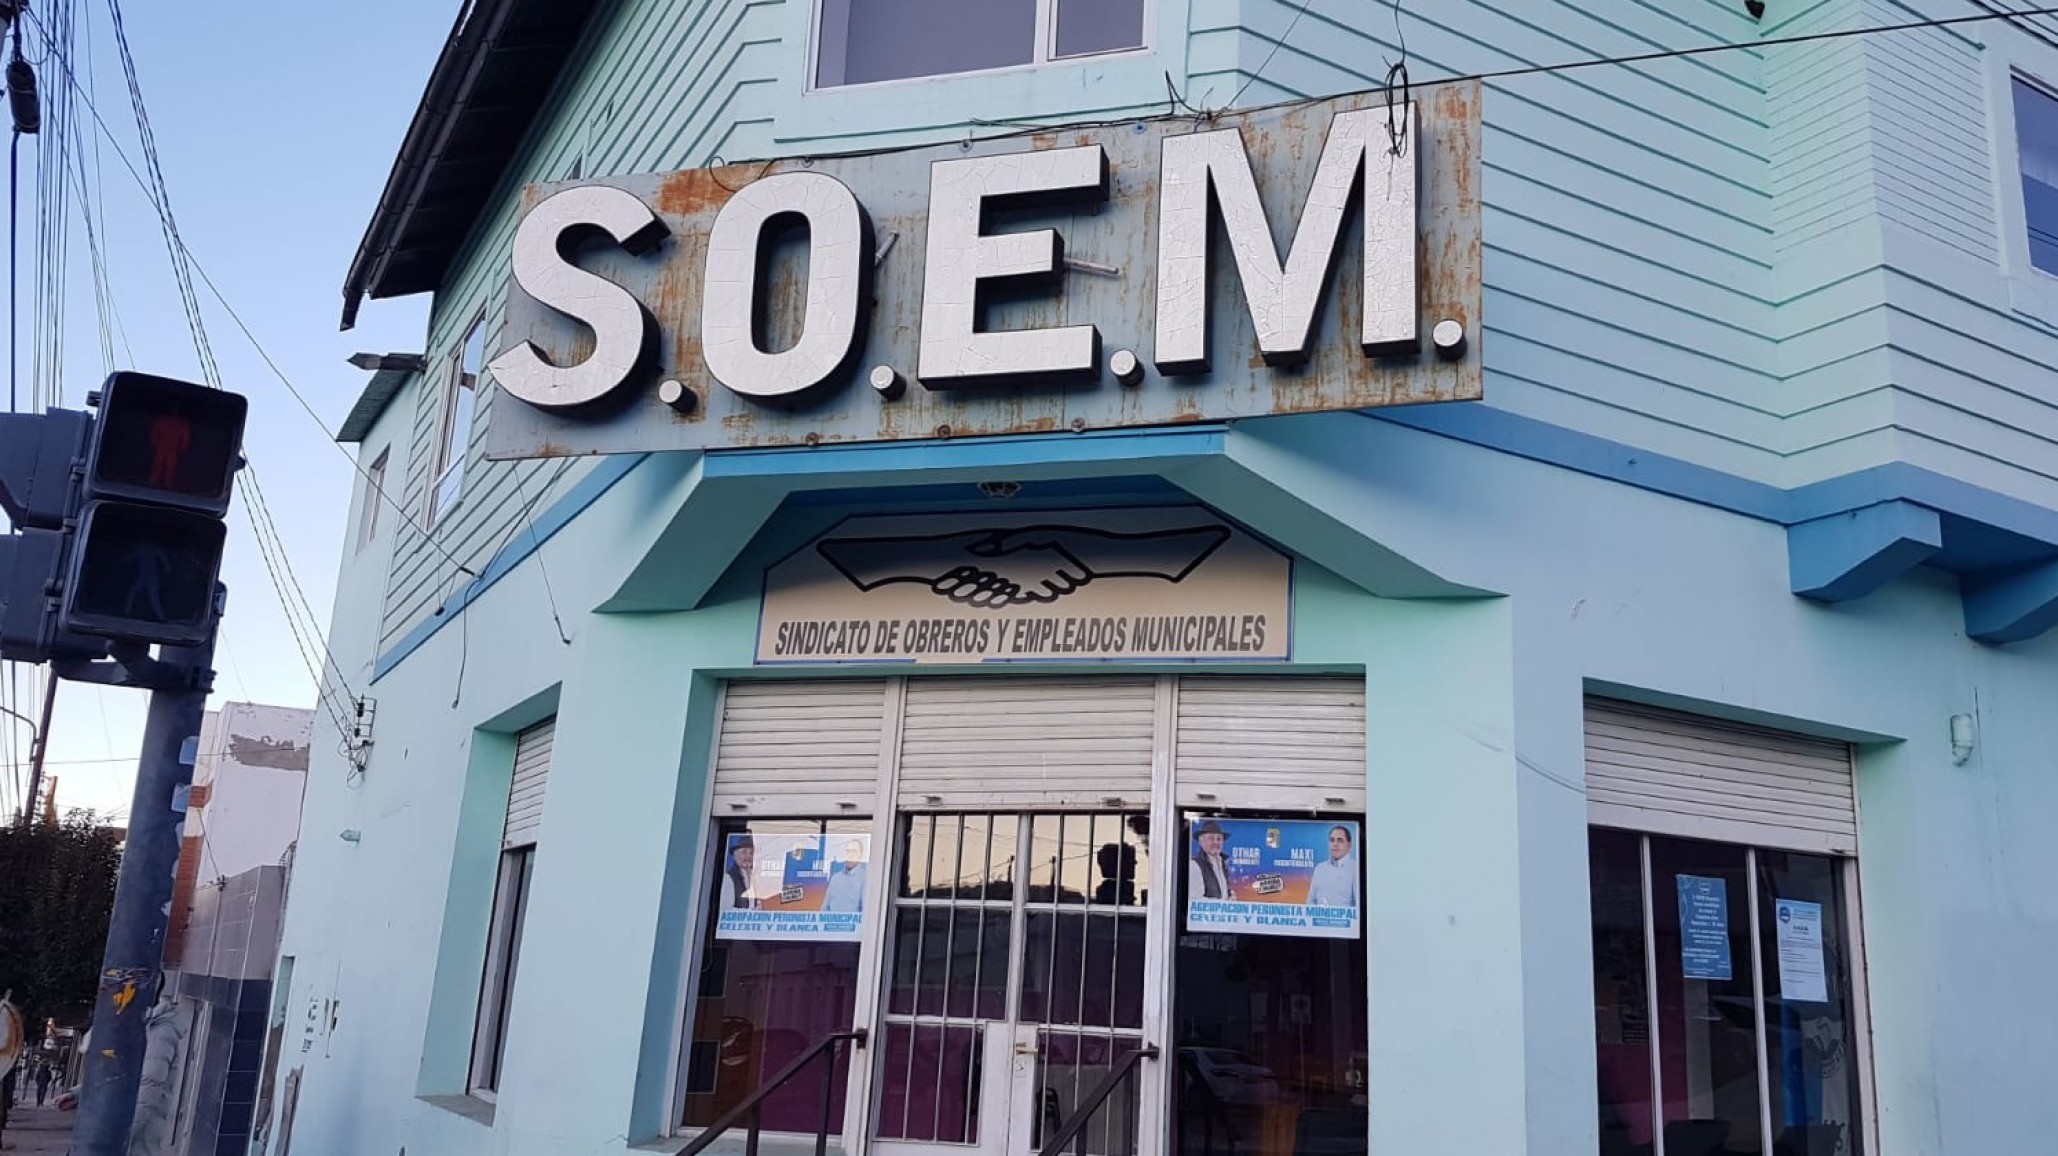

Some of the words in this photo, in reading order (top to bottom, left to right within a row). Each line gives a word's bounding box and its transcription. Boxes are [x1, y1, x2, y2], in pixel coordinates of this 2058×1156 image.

[487, 101, 1466, 412] S.O.E.M.
[775, 620, 871, 655] SINDICATO
[874, 620, 900, 653] DE
[903, 619, 991, 653] OBREROS
[997, 619, 1010, 652] Y
[1012, 617, 1127, 652] EMPLEADOS
[1131, 615, 1266, 652] MUNICIPALES
[1290, 848, 1314, 860] MAXI
[773, 912, 817, 923] PERONISTA
[1251, 904, 1303, 917] PERONISTA
[1306, 906, 1357, 920] MUNICIPAL
[1191, 914, 1240, 923] CELESTE
[1242, 915, 1250, 923] Y
[1257, 916, 1307, 926] BLANCA
[720, 922, 761, 931] CELESTE
[766, 923, 774, 931] Y
[777, 923, 819, 932] BLANCA
